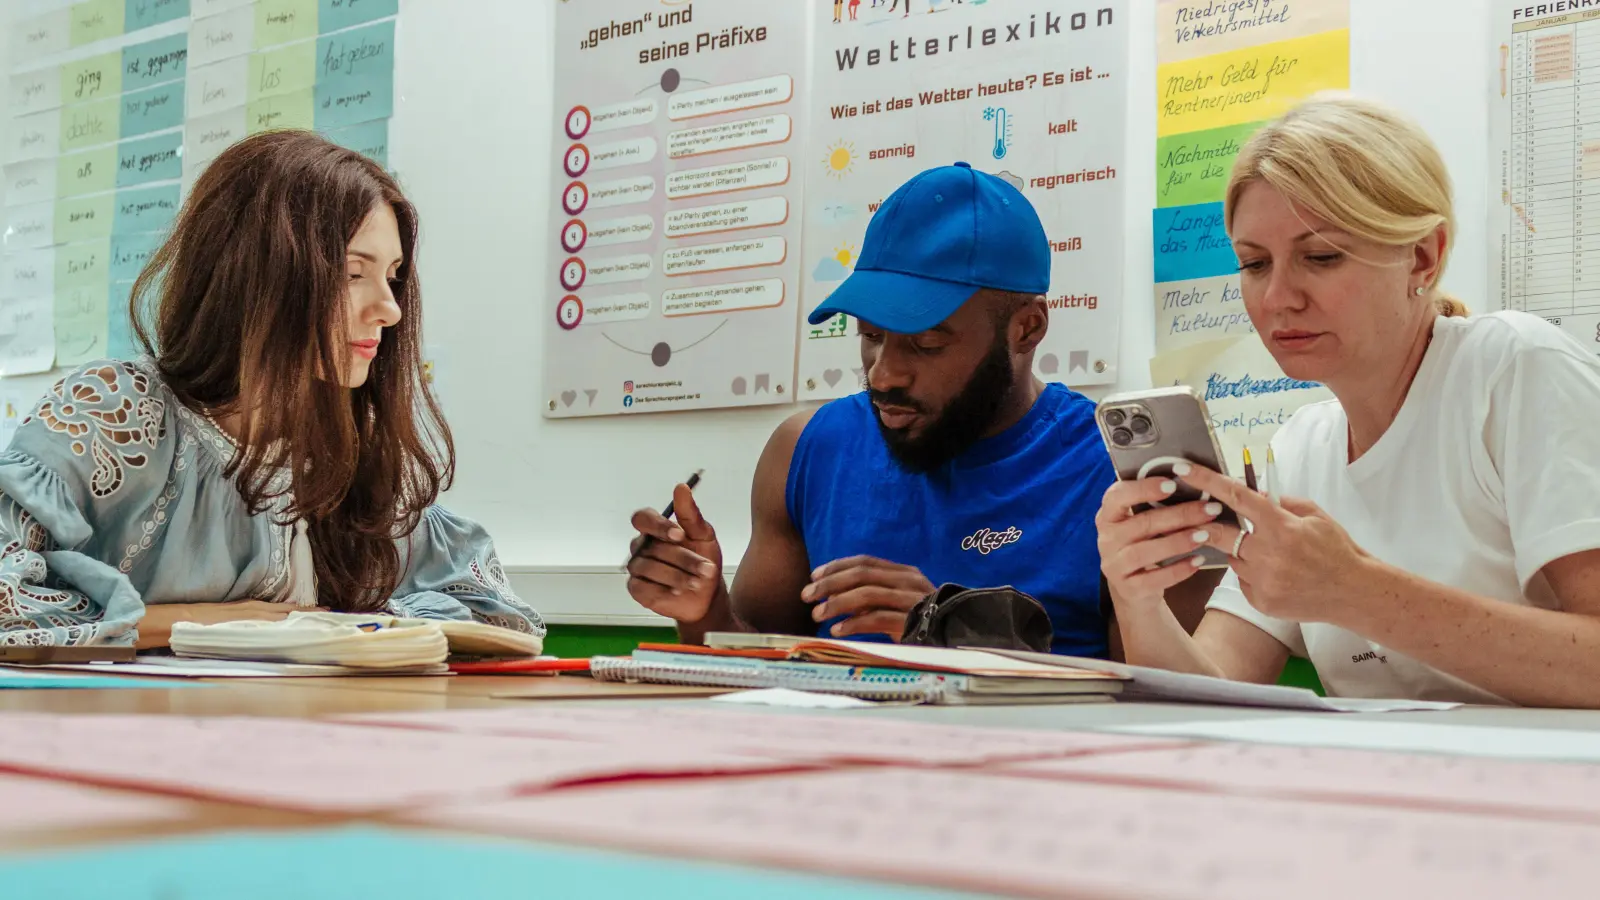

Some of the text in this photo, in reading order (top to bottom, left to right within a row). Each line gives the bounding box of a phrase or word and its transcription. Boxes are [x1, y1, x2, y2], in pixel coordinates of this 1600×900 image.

[658, 4, 692, 28] und
[1175, 4, 1291, 44] Verkehrsmittel
[1536, 16, 1568, 27] JANUAR
[639, 26, 767, 64] seine Präfixe
[836, 7, 1113, 71] Wetterlexikon
[127, 58, 140, 75] ist
[323, 40, 346, 77] hat
[75, 70, 101, 98] ging
[259, 55, 282, 93] las
[1166, 56, 1298, 98] Mehr Geld für
[831, 105, 857, 119] Wie
[862, 102, 881, 115] ist
[886, 97, 913, 111] das
[918, 88, 973, 106] Wetter
[978, 76, 1037, 97] heute?
[1043, 72, 1064, 87] Es
[1070, 66, 1093, 82] ist
[576, 118, 579, 127] 1
[1048, 120, 1077, 135] kalt
[574, 156, 579, 166] 2
[869, 143, 915, 160] sonnig
[1161, 140, 1240, 168] Nachmitta
[78, 162, 92, 178] aß
[121, 158, 135, 171] hat
[1030, 166, 1116, 189] regnerisch
[1162, 163, 1224, 196] für die
[573, 194, 578, 203] 3
[572, 232, 577, 242] 4
[1160, 238, 1188, 253] das
[570, 269, 575, 279] 5
[1048, 294, 1098, 310] wittrig
[1163, 283, 1242, 311] Mehr ko
[568, 309, 572, 318] 6
[1170, 310, 1255, 335] Kulturpro
[962, 526, 1023, 555] Magic
